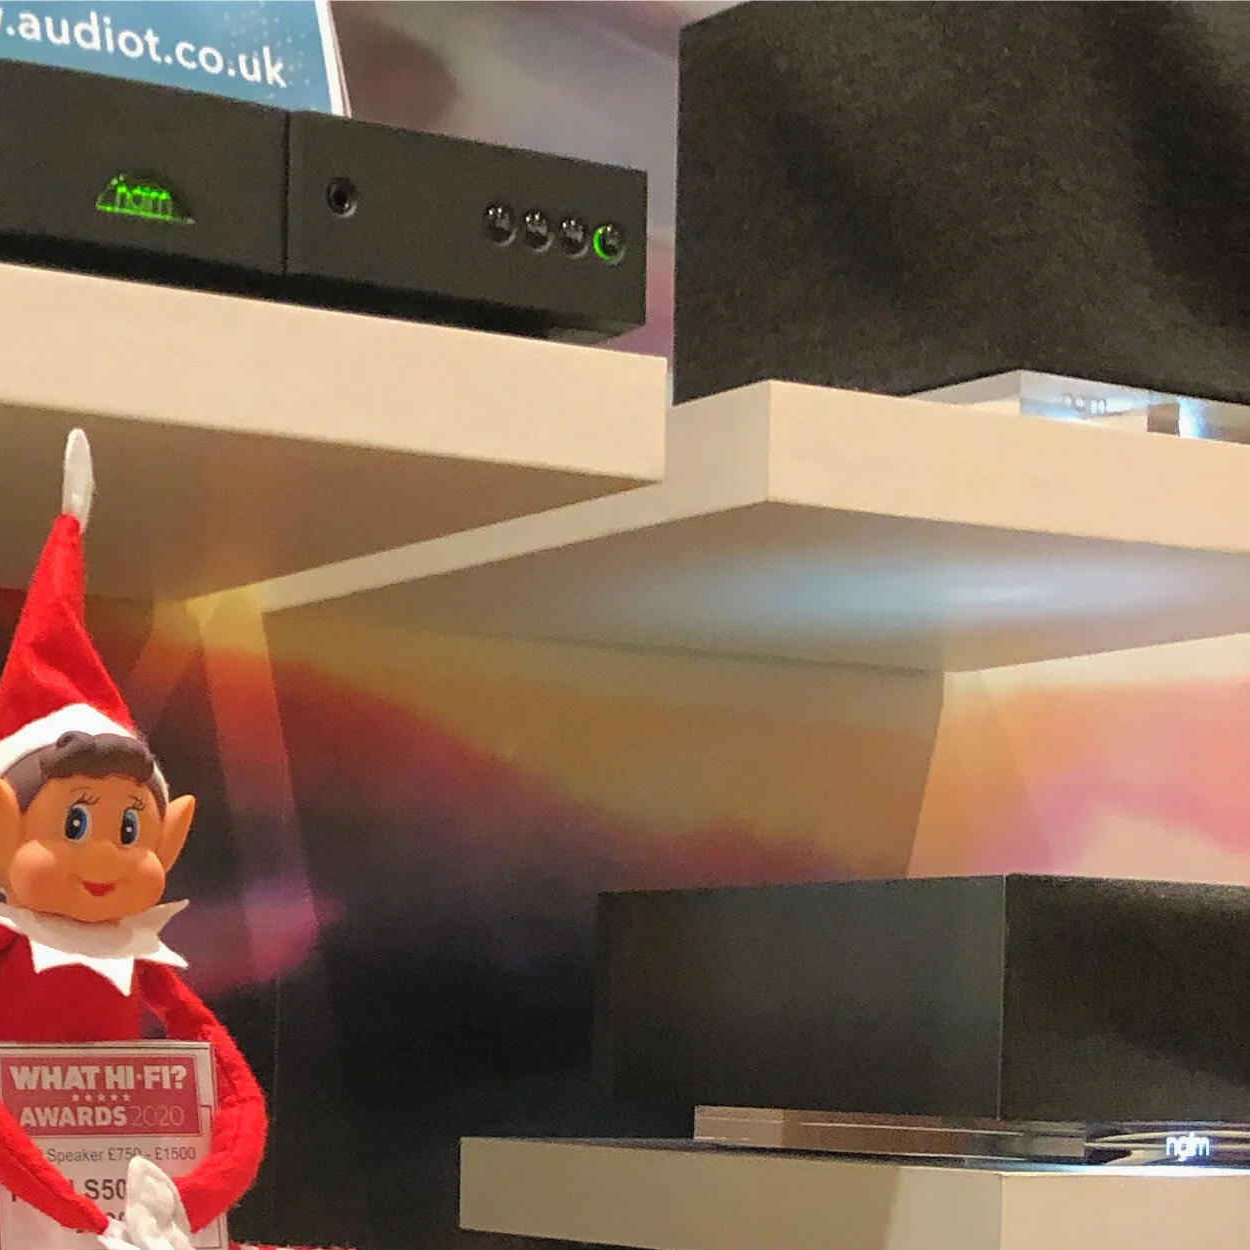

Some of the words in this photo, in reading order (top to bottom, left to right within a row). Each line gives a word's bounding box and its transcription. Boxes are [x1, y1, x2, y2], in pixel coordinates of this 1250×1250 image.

[9, 1064, 100, 1091] WHAT
[19, 1106, 127, 1128] AWARDS
[129, 1105, 185, 1126] 2020
[47, 1147, 104, 1165] Speaker
[155, 1146, 196, 1161] £1500
